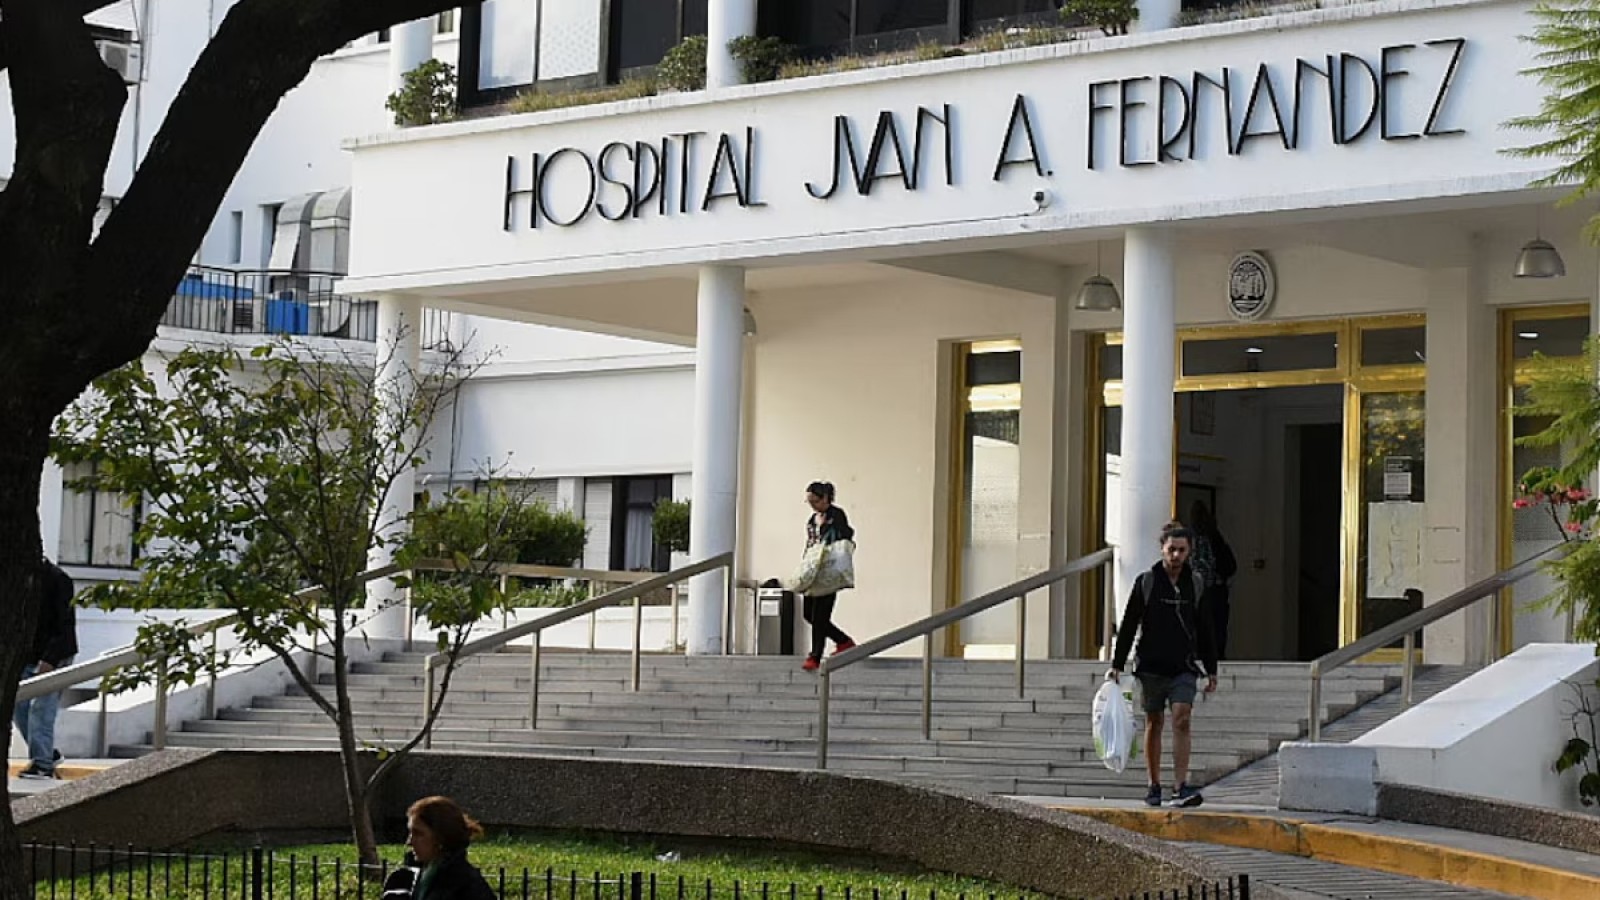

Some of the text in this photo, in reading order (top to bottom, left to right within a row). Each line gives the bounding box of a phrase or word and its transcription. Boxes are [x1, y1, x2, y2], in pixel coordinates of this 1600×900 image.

[503, 126, 767, 232] HOSPITAL
[993, 93, 1053, 182] A.
[1087, 36, 1467, 170] FERNANDEZ
